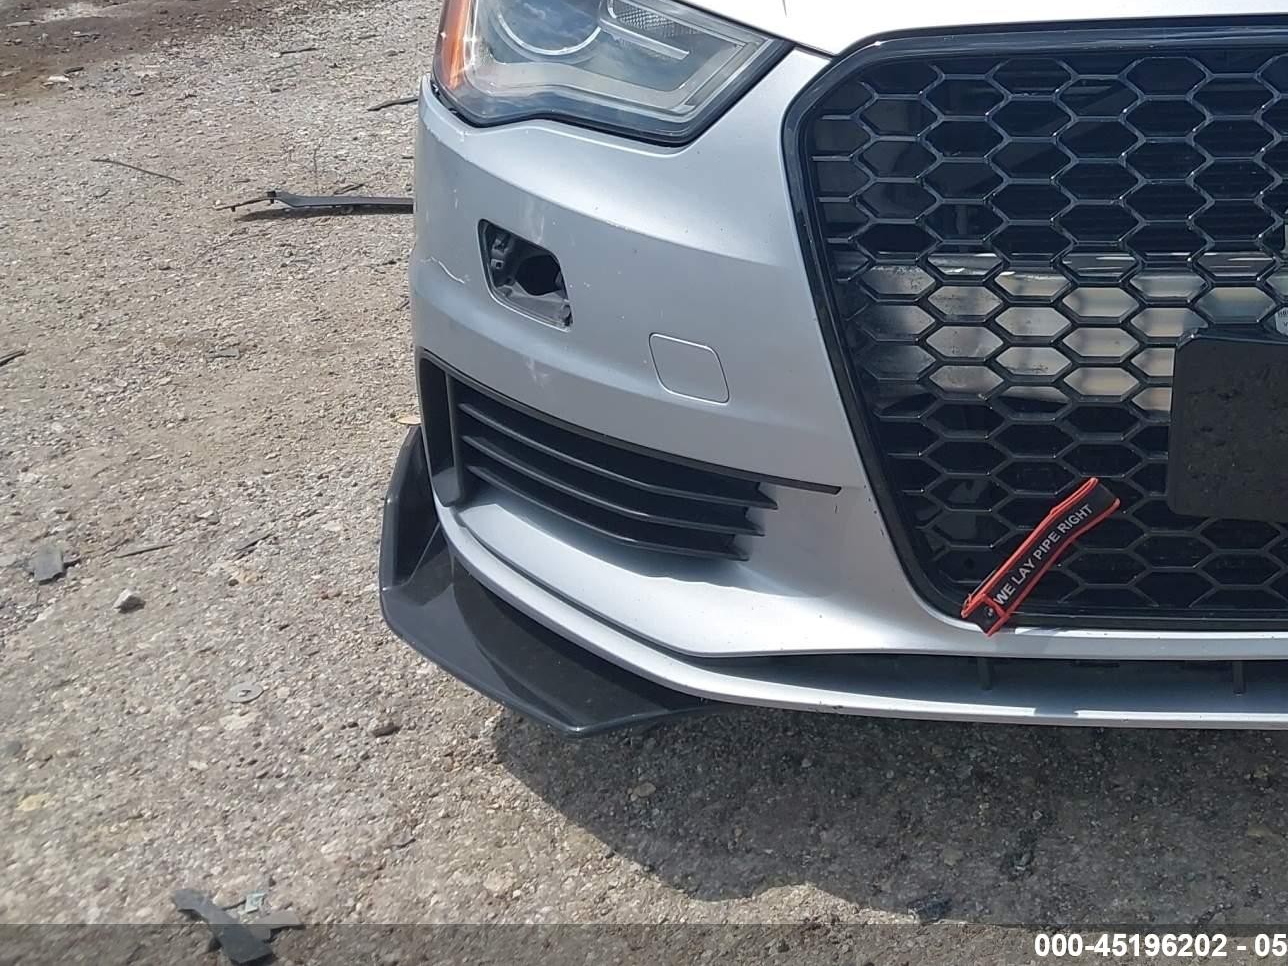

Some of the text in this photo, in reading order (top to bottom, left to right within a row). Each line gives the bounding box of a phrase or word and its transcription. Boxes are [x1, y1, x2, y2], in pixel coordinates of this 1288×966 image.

[993, 503, 1093, 606] WE LAY PIPE RIGHT
